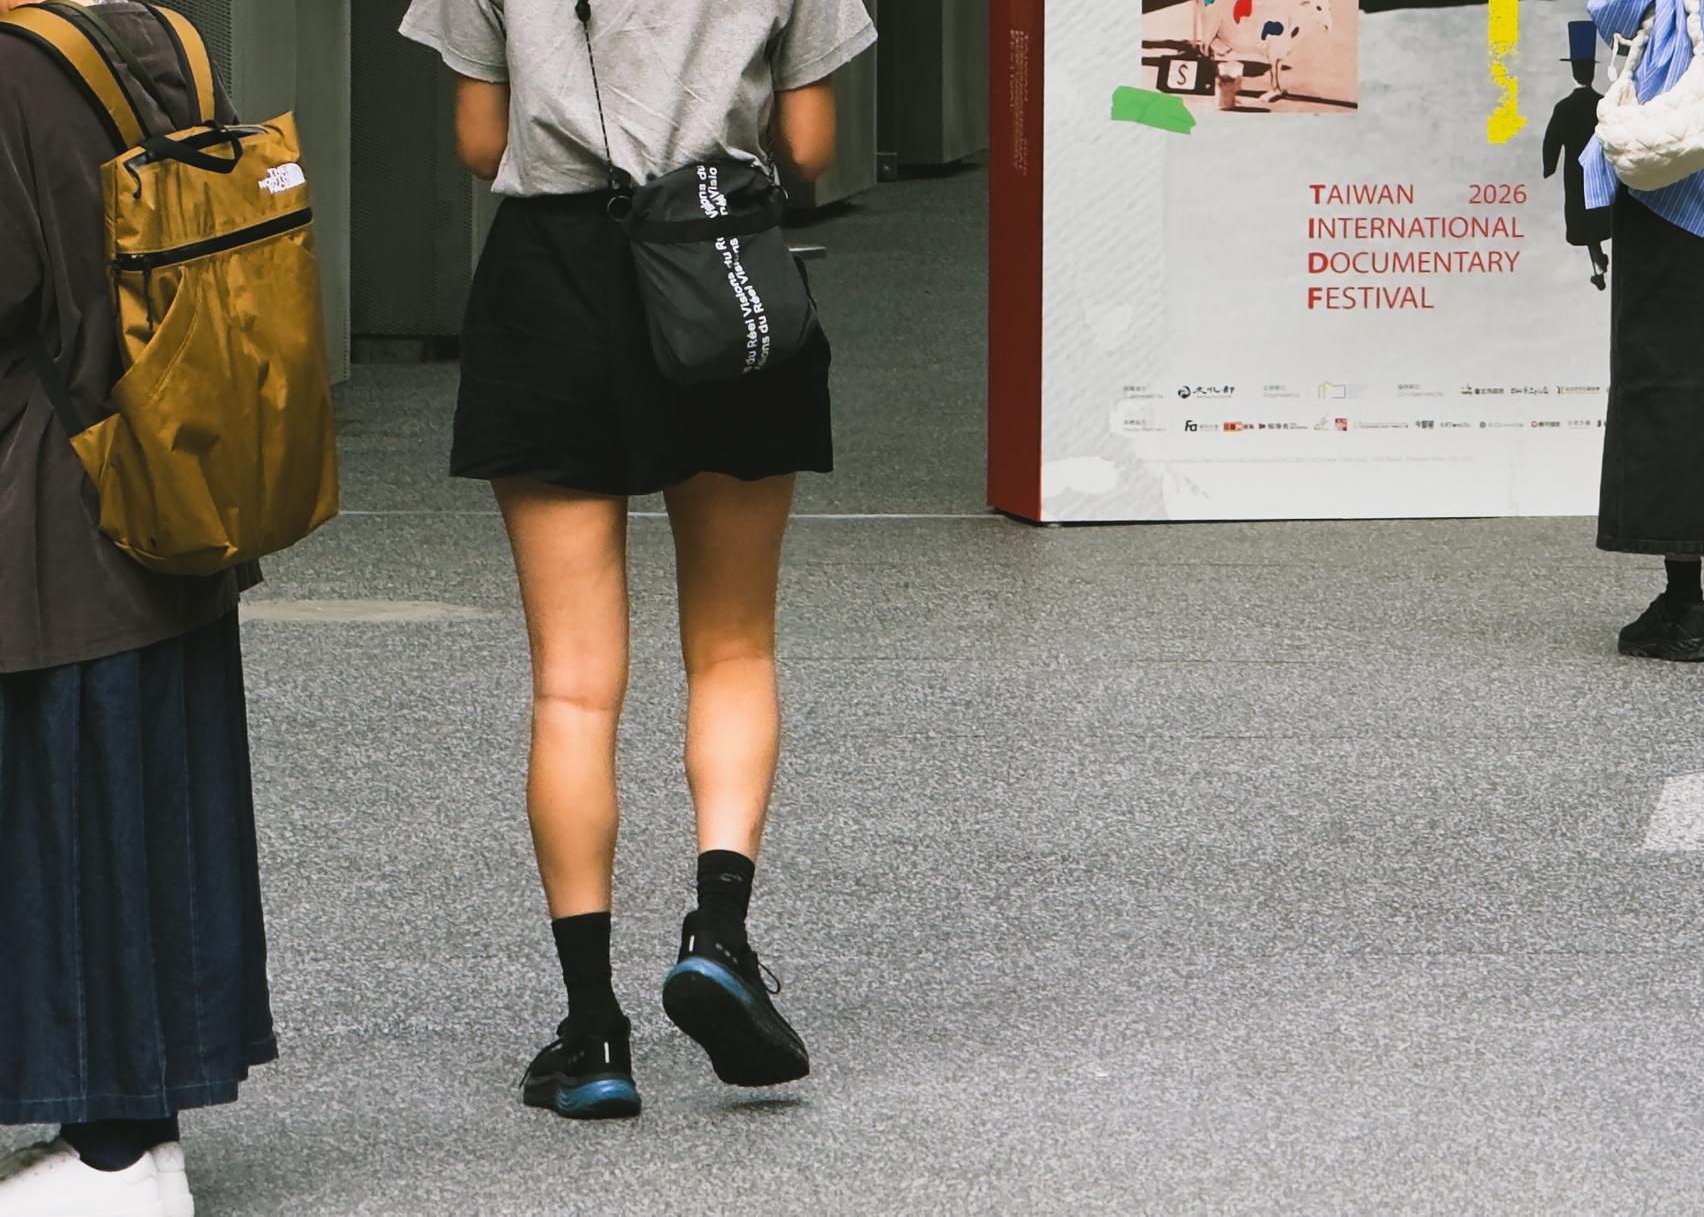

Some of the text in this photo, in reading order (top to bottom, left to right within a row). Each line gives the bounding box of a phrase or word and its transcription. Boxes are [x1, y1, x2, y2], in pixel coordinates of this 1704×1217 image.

[1310, 183, 1527, 206] TAIWAN 2026
[1307, 216, 1524, 240] INTERNATIONAL
[1307, 250, 1517, 275] DOCUMENTARY
[727, 272, 753, 318] Visions
[744, 286, 765, 314] Réel
[1307, 286, 1434, 310] FESTIVAL
[757, 315, 769, 334] du
